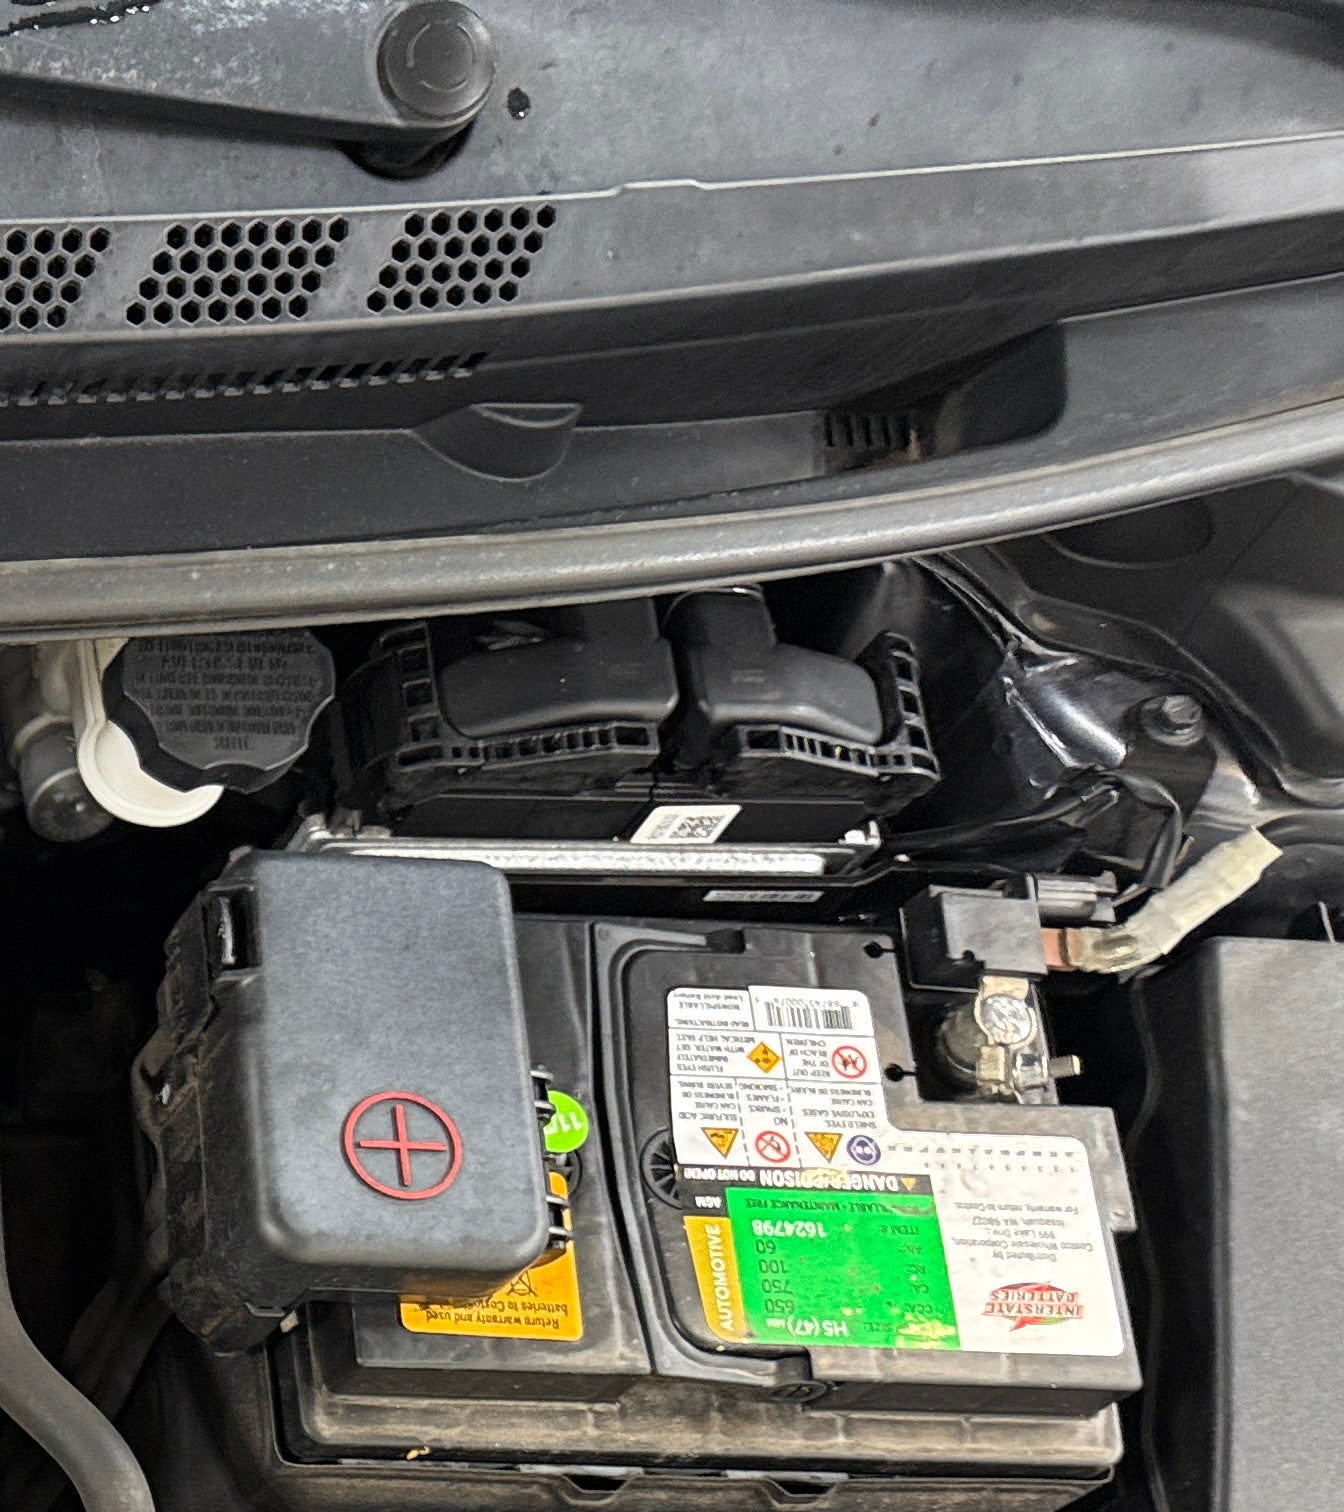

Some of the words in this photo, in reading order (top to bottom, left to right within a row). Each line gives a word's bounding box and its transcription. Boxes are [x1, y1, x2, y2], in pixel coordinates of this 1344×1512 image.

[698, 1035, 719, 1043] HELP
[773, 1117, 789, 1127] NO
[717, 1169, 739, 1182] NOT
[739, 1170, 756, 1183] DO
[744, 1198, 768, 1209] FREE
[769, 1199, 841, 1212] MAINTENANCE
[986, 1203, 997, 1212] to
[997, 1204, 1023, 1213] return
[1064, 1206, 1079, 1216] For
[751, 1219, 828, 1239] 1624798
[1003, 1218, 1019, 1227] WA
[1014, 1229, 1037, 1240] Lake
[1038, 1230, 1056, 1240] 999
[754, 1238, 777, 1255] 60
[1010, 1240, 1058, 1251] Wholesale
[1060, 1242, 1094, 1253] Costco
[992, 1249, 1005, 1261] by
[1006, 1252, 1057, 1263] Distributed
[758, 1258, 790, 1275] 100
[704, 1223, 736, 1332] AUTOMOTIVE
[761, 1278, 794, 1296] 750
[991, 1290, 1076, 1303] BATTERIES
[507, 1301, 519, 1312] to
[520, 1301, 569, 1317] batteries
[764, 1298, 796, 1315] 650
[984, 1302, 1081, 1318] INTERSTATE
[426, 1310, 452, 1323] used
[454, 1313, 473, 1325] and
[476, 1311, 522, 1327] warranty
[524, 1316, 560, 1330] Return
[786, 1315, 821, 1337] (47)
